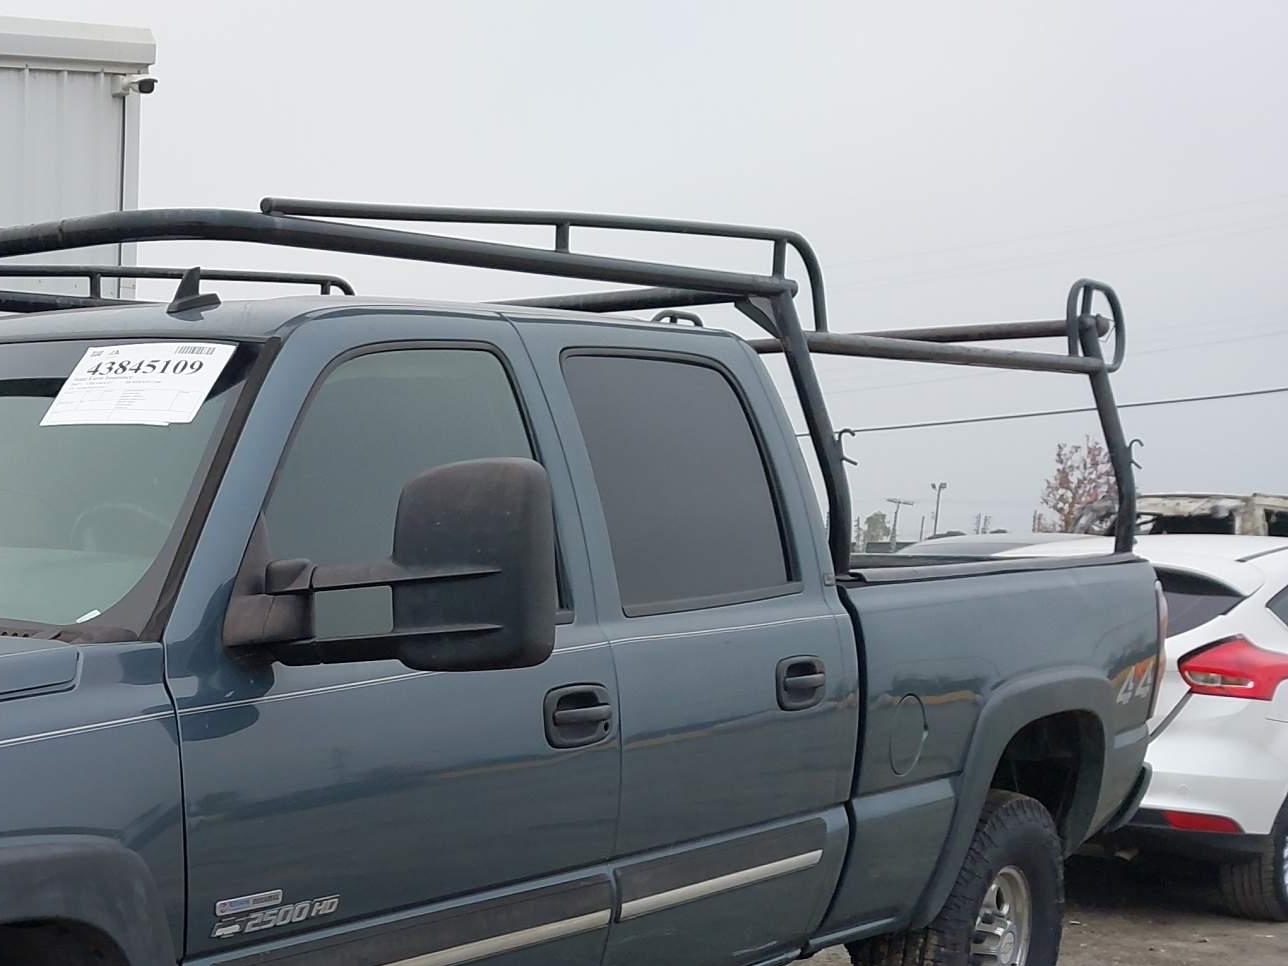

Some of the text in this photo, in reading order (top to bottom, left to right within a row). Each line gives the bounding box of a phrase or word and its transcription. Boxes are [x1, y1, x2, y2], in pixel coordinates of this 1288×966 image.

[87, 359, 203, 376] 43845109
[244, 902, 311, 932] 2500
[312, 897, 340, 916] HD
